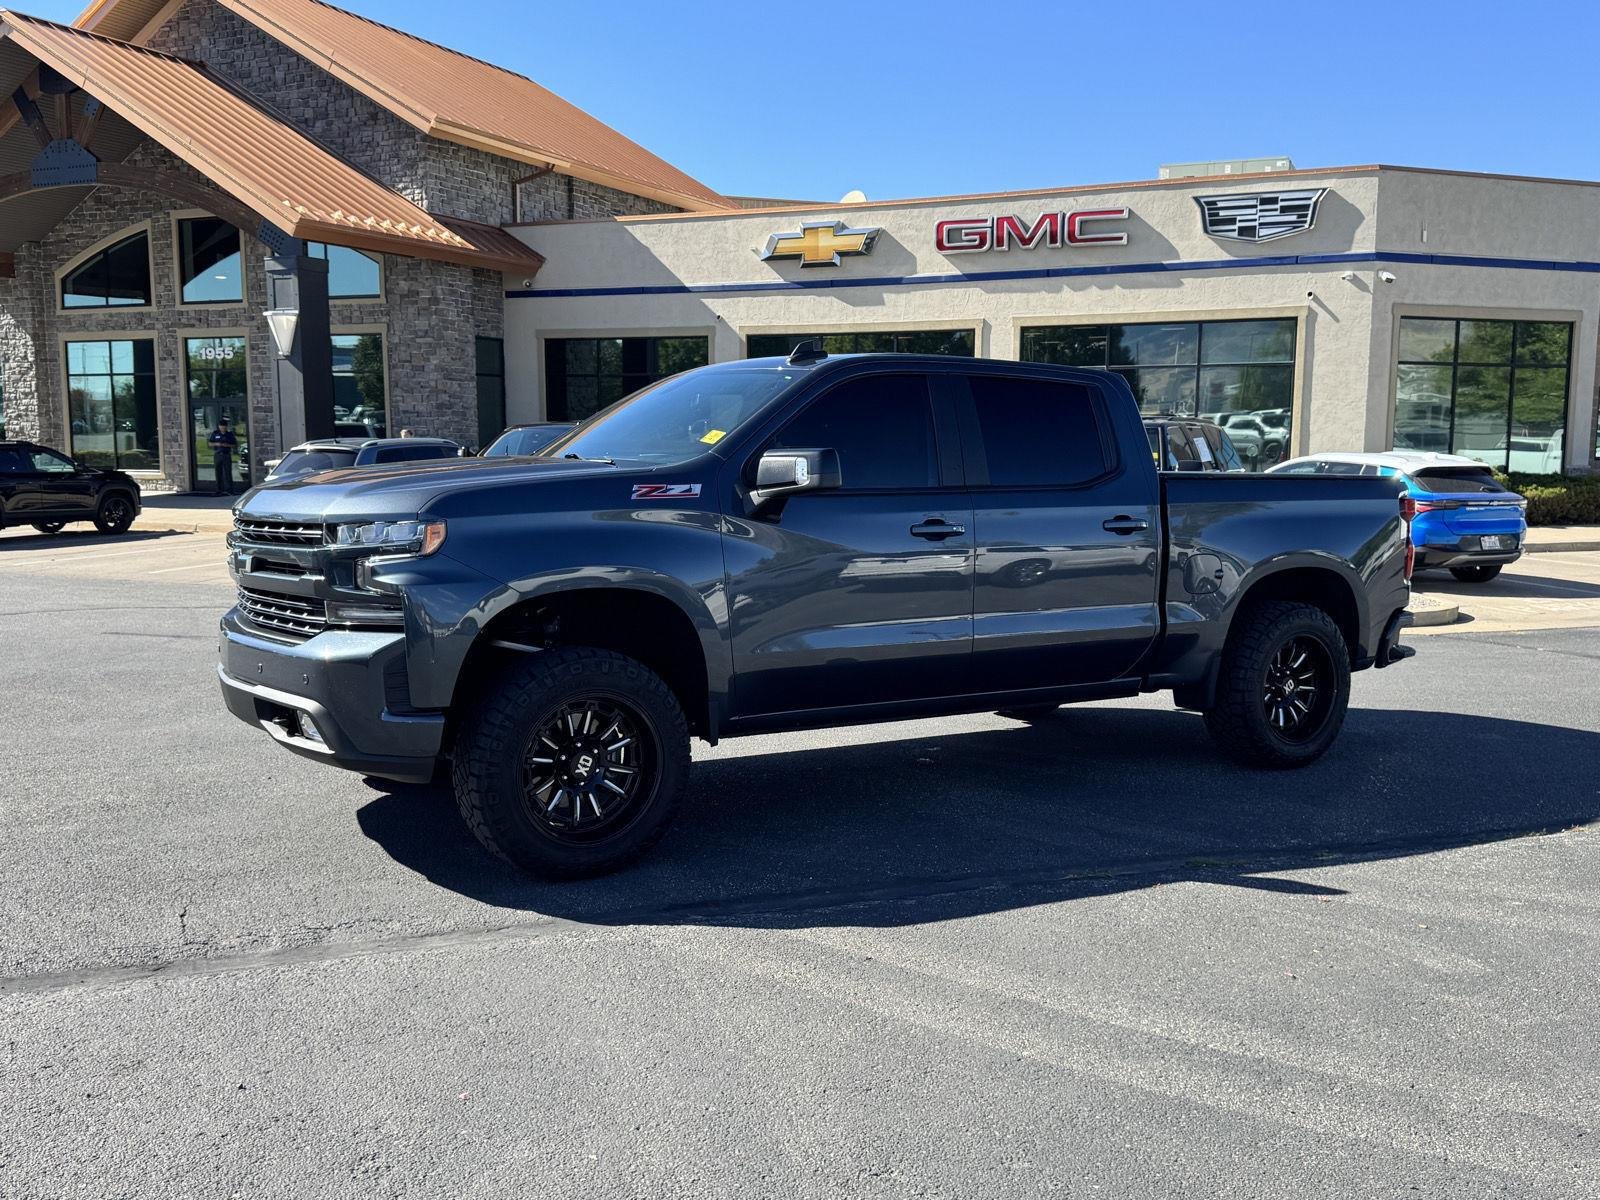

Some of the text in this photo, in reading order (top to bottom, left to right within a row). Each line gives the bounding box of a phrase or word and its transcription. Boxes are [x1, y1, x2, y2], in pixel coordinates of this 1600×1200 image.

[934, 206, 1129, 254] GMC
[200, 346, 234, 360] 1955
[630, 483, 703, 500] Z71
[574, 755, 593, 777] XD
